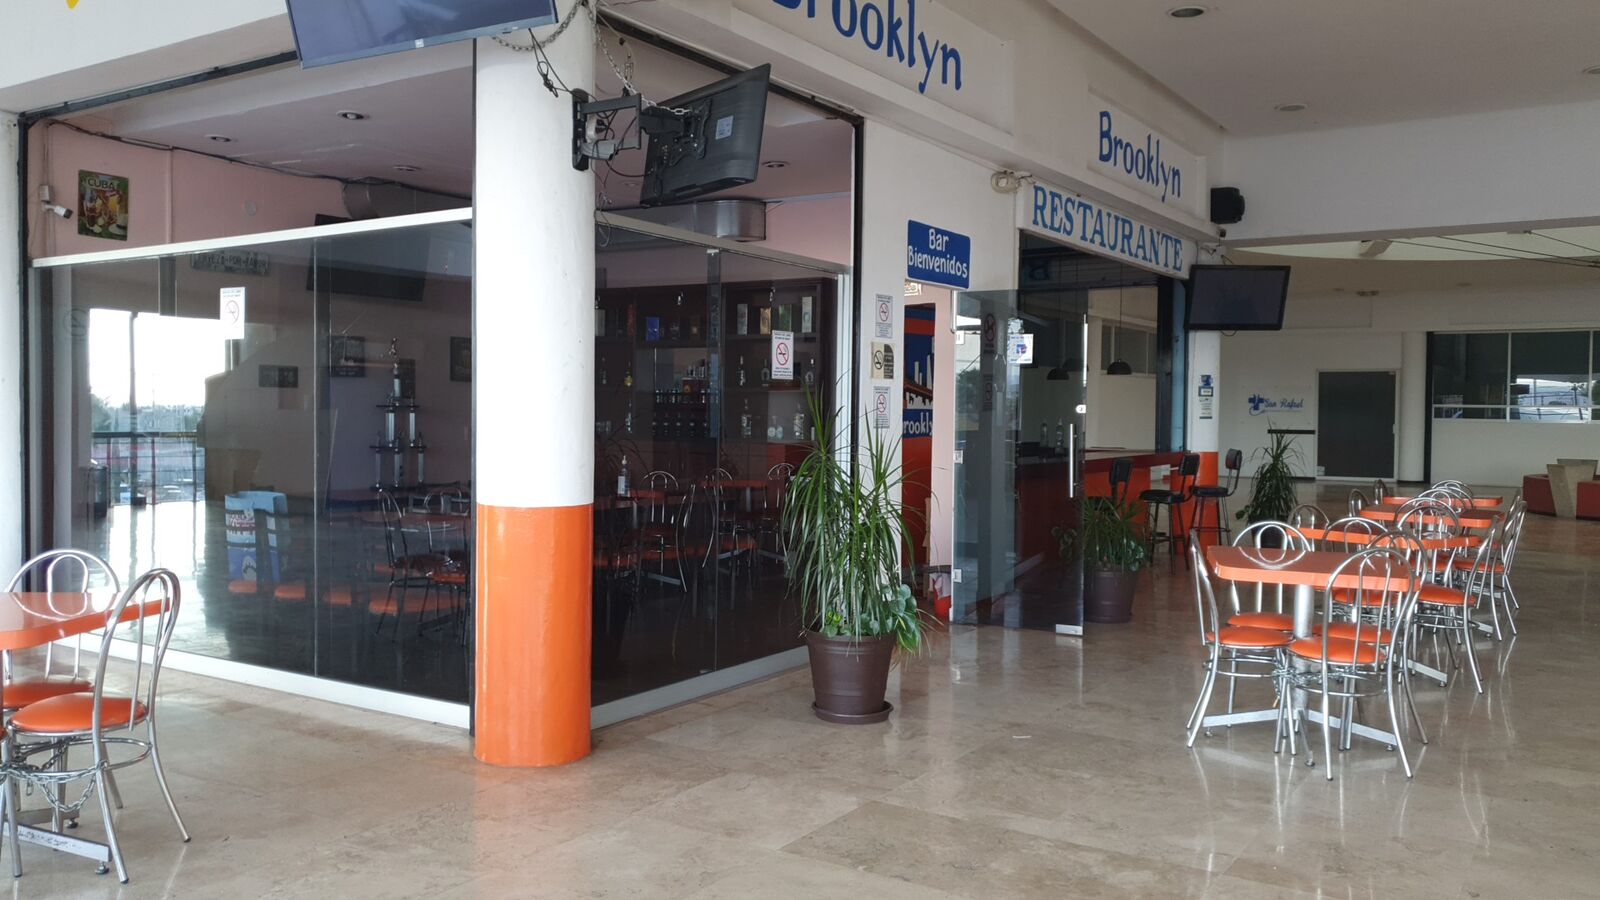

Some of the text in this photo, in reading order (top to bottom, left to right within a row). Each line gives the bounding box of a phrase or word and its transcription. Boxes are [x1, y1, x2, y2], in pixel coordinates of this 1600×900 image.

[773, 0, 962, 94] ooklyn
[87, 177, 117, 191] CUBA
[1098, 110, 1181, 203] Brooklyn
[929, 228, 949, 252] Bar
[1032, 185, 1183, 272] RESTAURANTE
[908, 245, 968, 279] Bienvenidos
